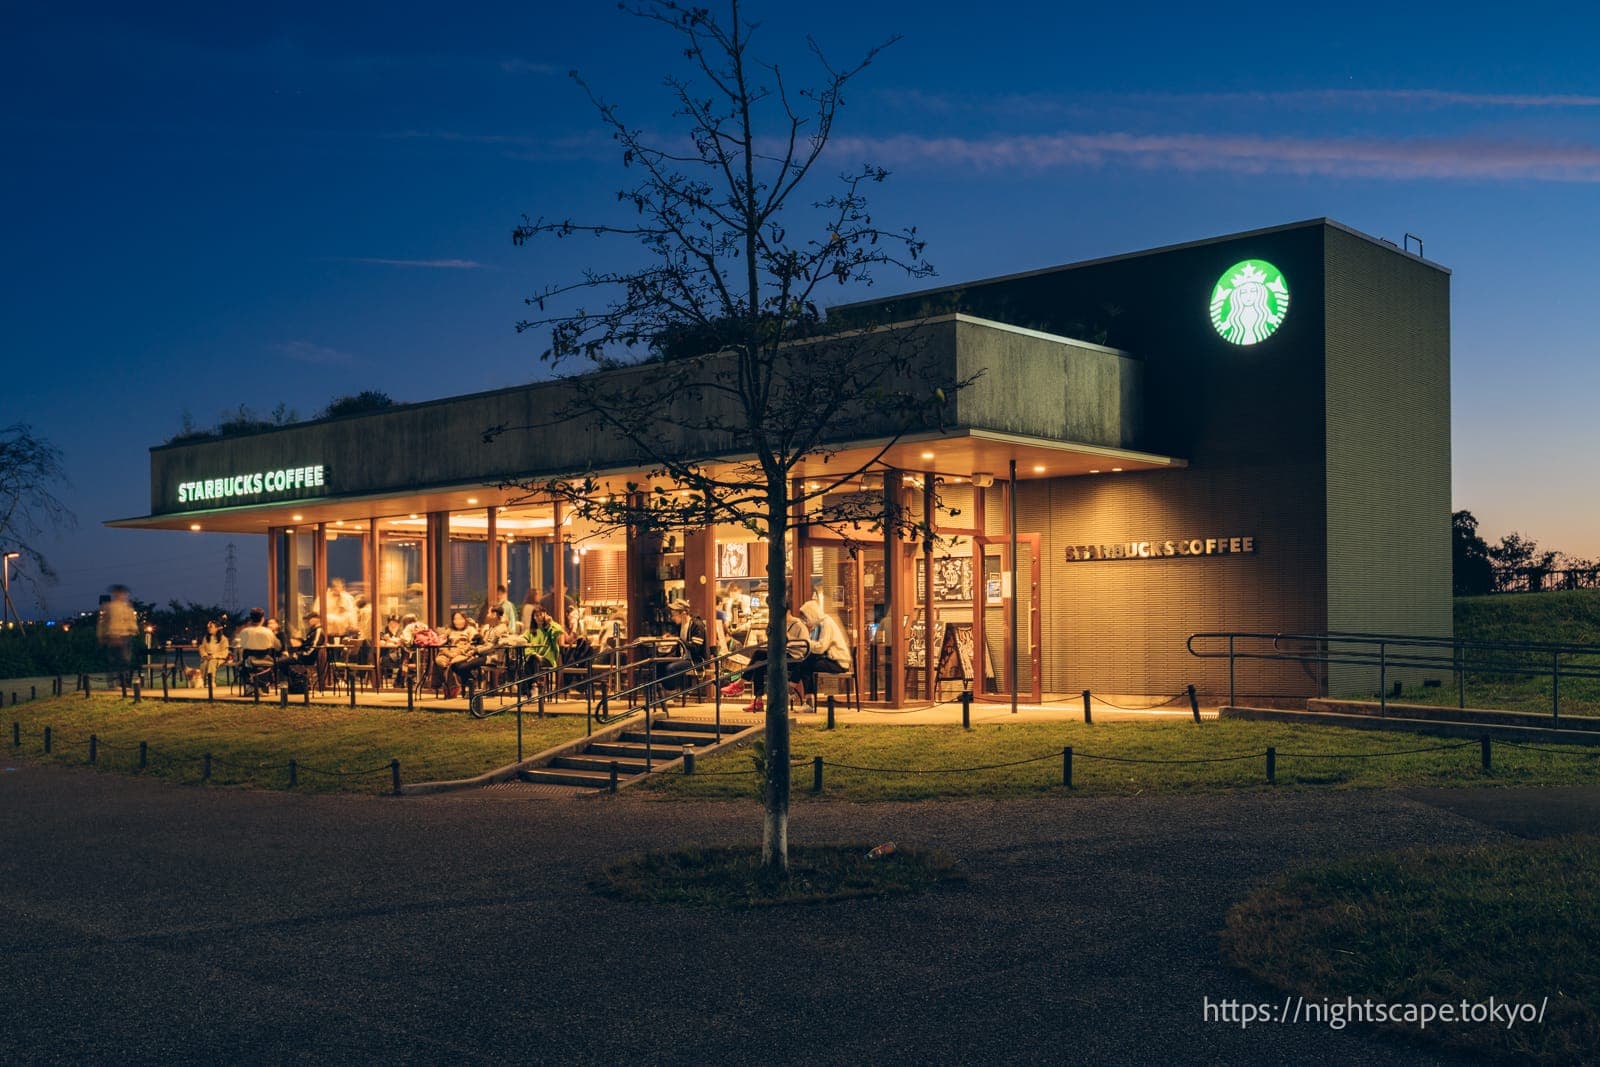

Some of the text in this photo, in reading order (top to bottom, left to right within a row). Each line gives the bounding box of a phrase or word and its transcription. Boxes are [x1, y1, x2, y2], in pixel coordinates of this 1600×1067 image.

[178, 465, 324, 502] STARBUCKS COFFEE
[1065, 536, 1254, 561] STARBUCKS COFFEE
